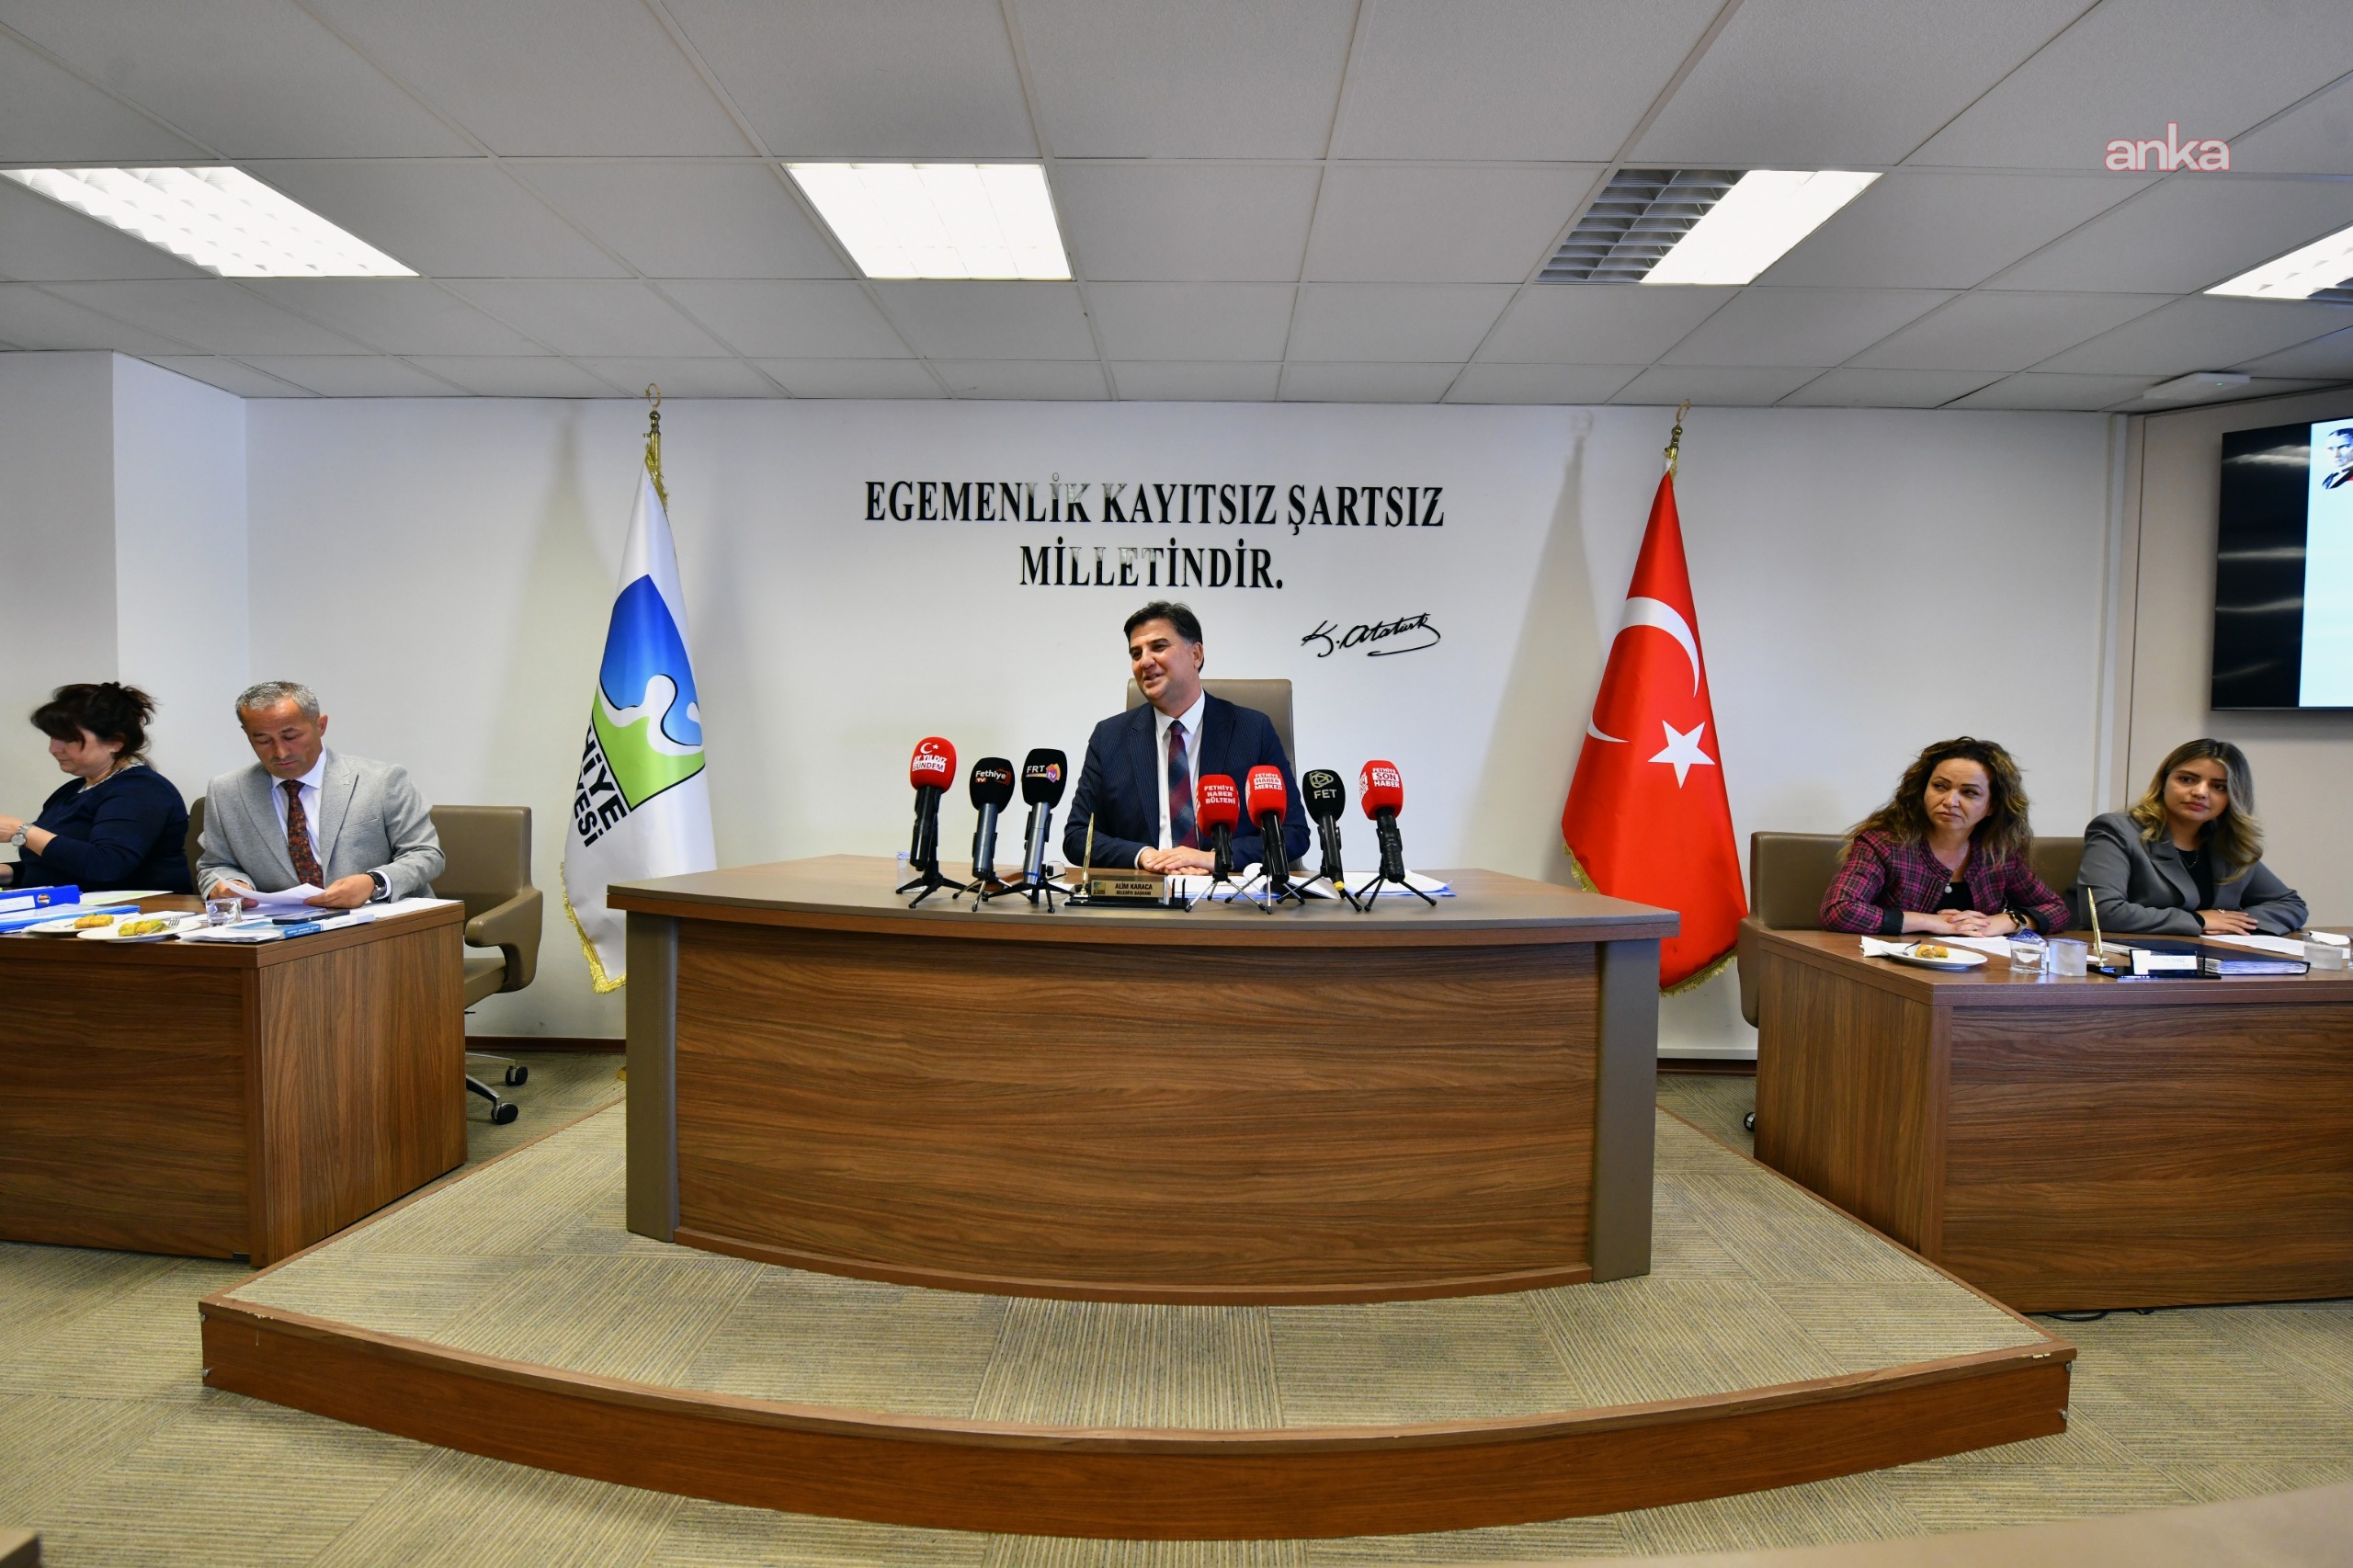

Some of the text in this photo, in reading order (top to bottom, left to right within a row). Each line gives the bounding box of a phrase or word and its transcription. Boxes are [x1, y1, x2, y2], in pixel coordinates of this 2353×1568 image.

[864, 472, 1445, 536] EGEMENLİK KAYITSIZ ŞARTSIZ
[1019, 536, 1283, 589] MİLLETİNDİR.
[922, 755, 948, 764] YILDIZ
[975, 769, 1006, 780] Fethiye
[1026, 765, 1057, 779] FRT tv
[1376, 772, 1397, 781] SON
[1373, 779, 1401, 789] HABER
[1313, 789, 1337, 800] FET
